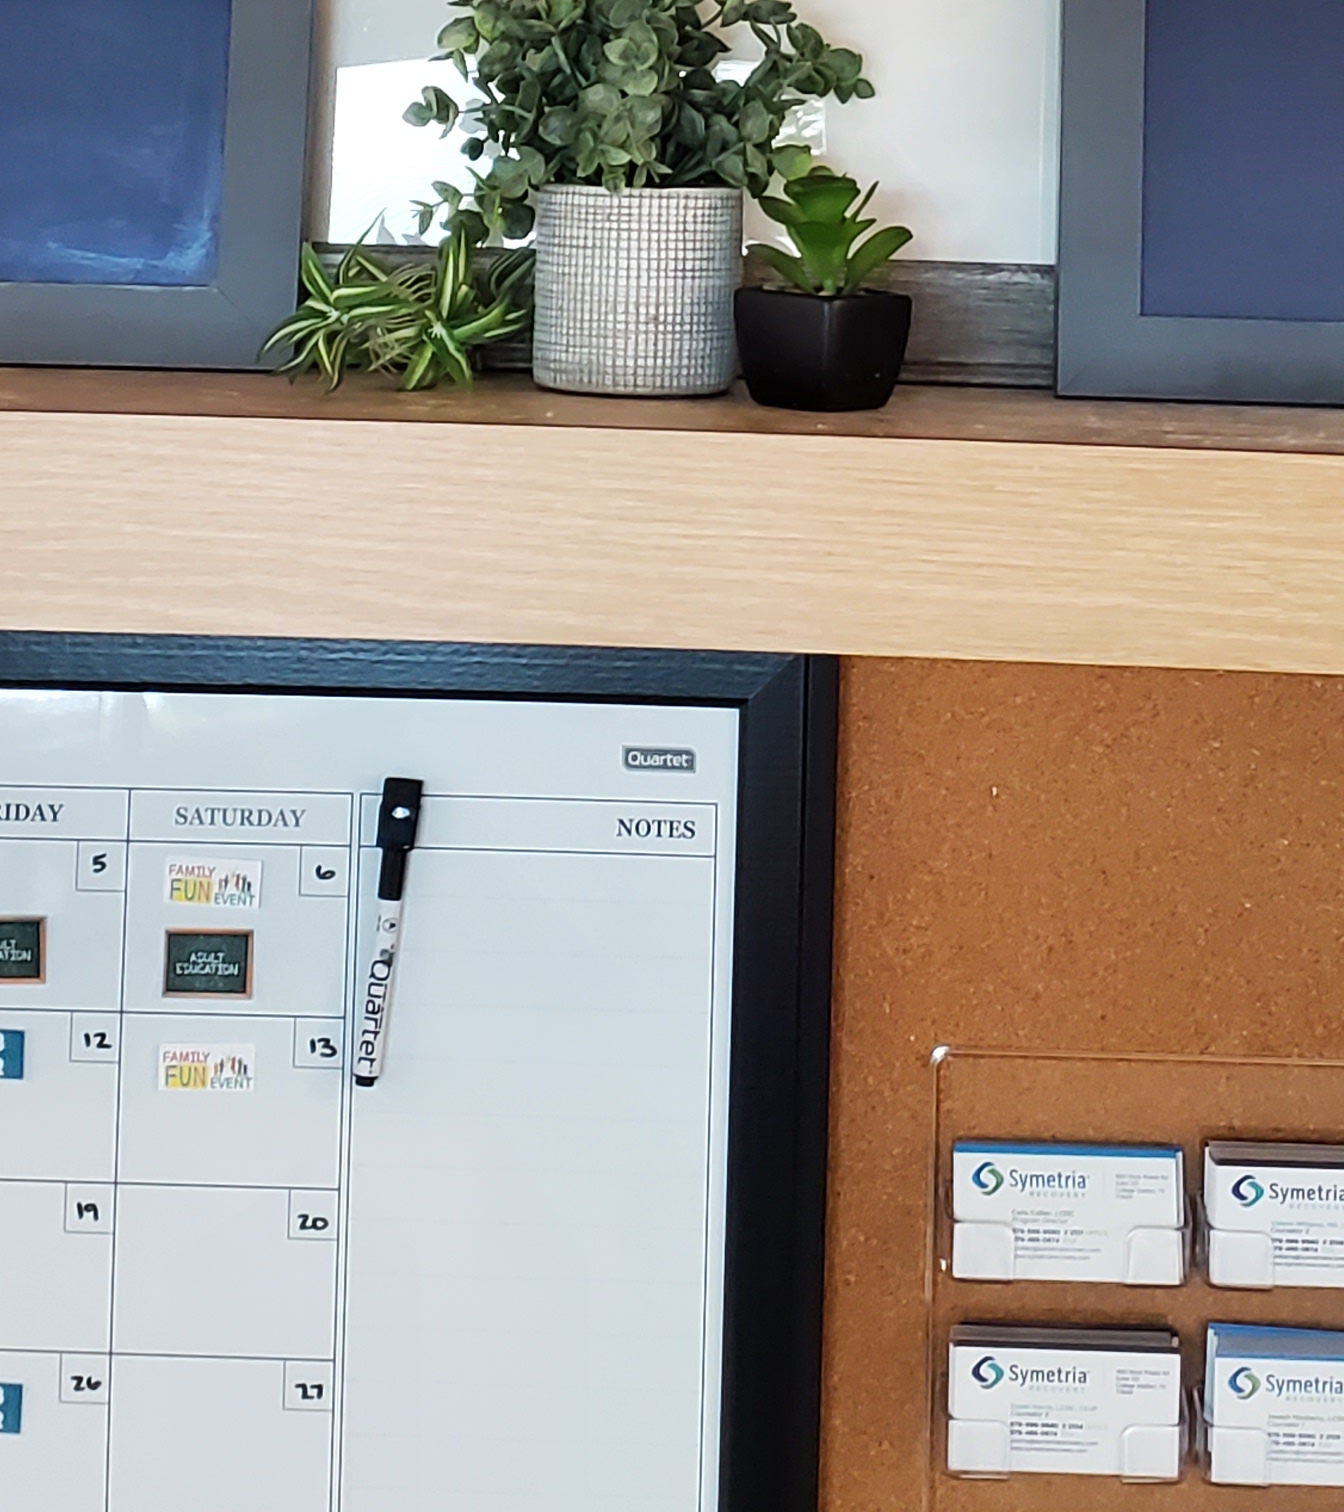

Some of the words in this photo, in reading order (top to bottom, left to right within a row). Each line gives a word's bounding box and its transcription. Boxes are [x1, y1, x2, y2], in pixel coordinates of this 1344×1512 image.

[627, 748, 691, 770] Quartet
[174, 806, 306, 828] SATURDAY
[617, 818, 696, 839] NOTES
[92, 853, 107, 874] 5
[168, 864, 216, 878] FAMILY
[315, 864, 336, 880] 6
[169, 877, 212, 901] FUN
[214, 892, 256, 907] EVENT
[189, 951, 226, 964] ADULT
[175, 962, 239, 976] EDUCATION
[357, 959, 392, 1066] Quartet
[83, 1032, 113, 1049] 12
[309, 1037, 338, 1058] 13
[162, 1050, 210, 1063] FAMILY
[164, 1065, 208, 1087] FUN
[210, 1076, 253, 1089] EVENT
[1009, 1168, 1086, 1193] Symetria
[76, 1202, 99, 1221] 19
[297, 1213, 329, 1231] 20
[70, 1375, 102, 1392] 26
[1008, 1364, 1087, 1387] Symetria
[1265, 1374, 1344, 1397] Symetria
[294, 1382, 324, 1400] 27
